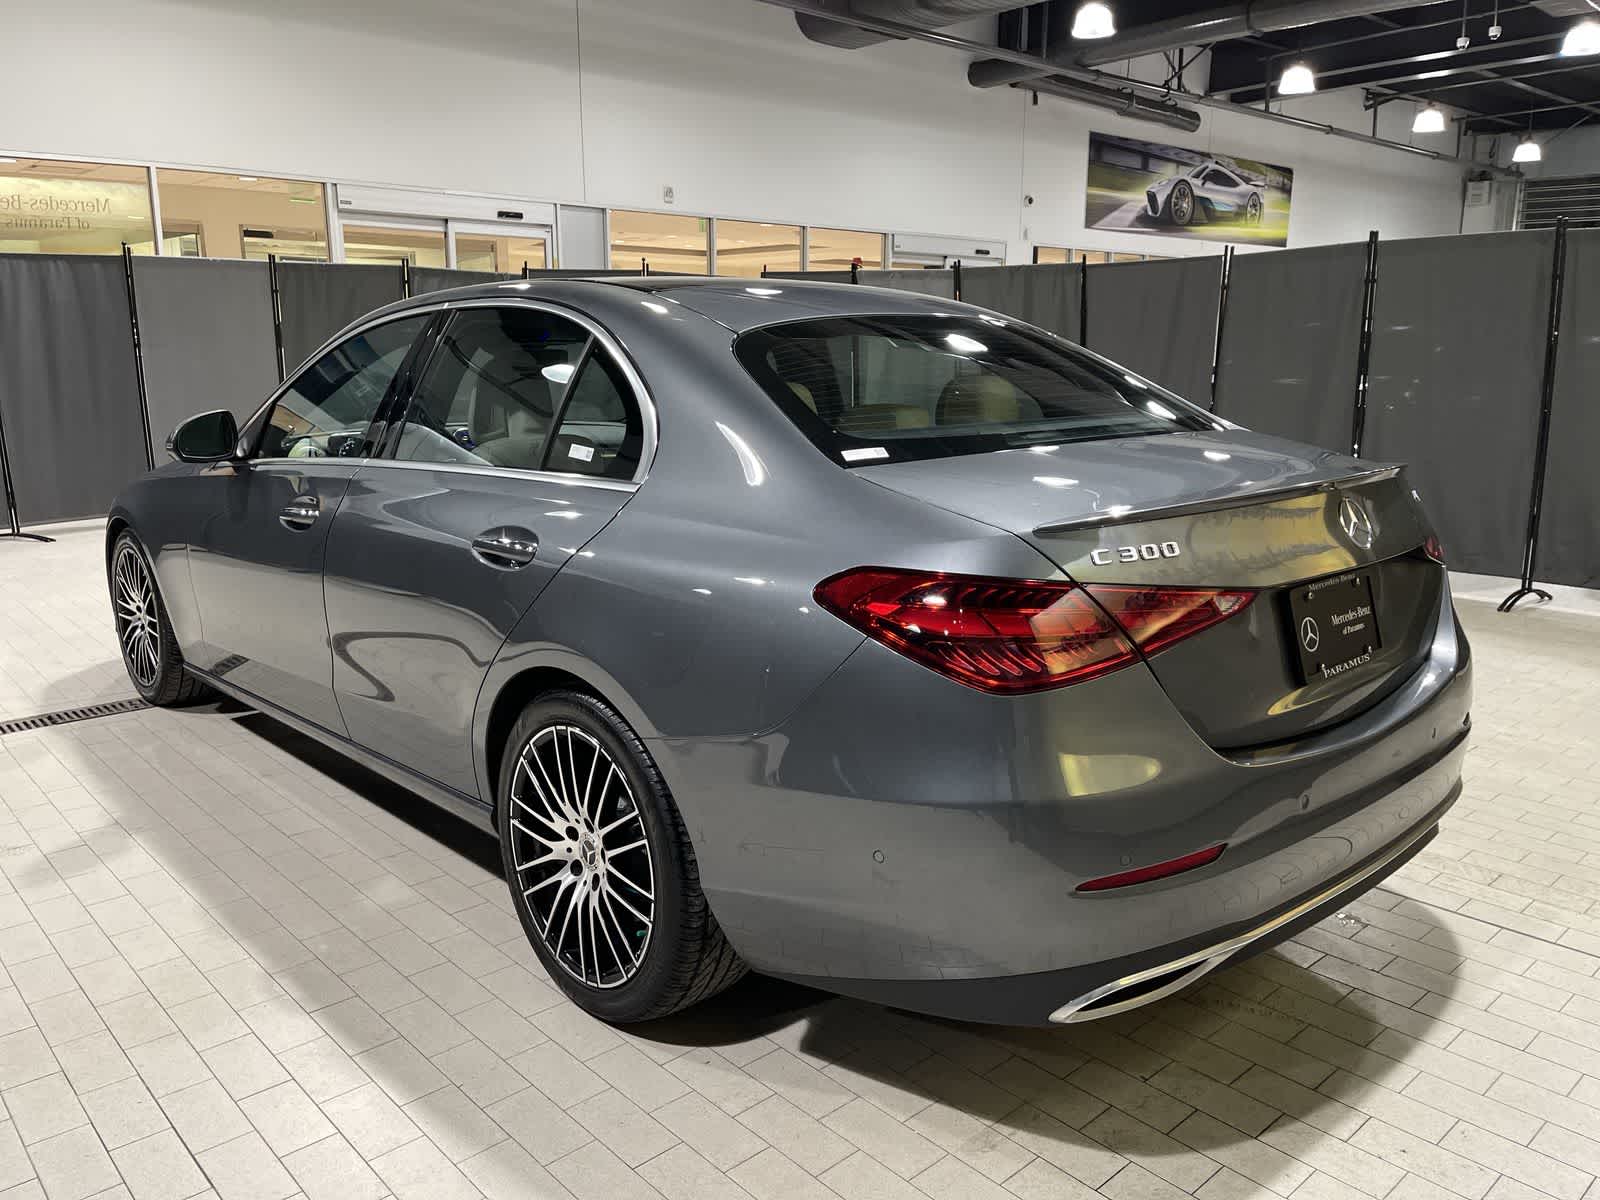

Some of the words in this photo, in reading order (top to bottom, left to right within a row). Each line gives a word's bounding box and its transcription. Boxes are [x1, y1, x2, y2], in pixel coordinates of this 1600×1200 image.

[1090, 548, 1112, 566] C
[1117, 541, 1181, 563] 300
[1331, 606, 1371, 625] Mercedes-Benz
[1323, 654, 1370, 678] PARAMUS
